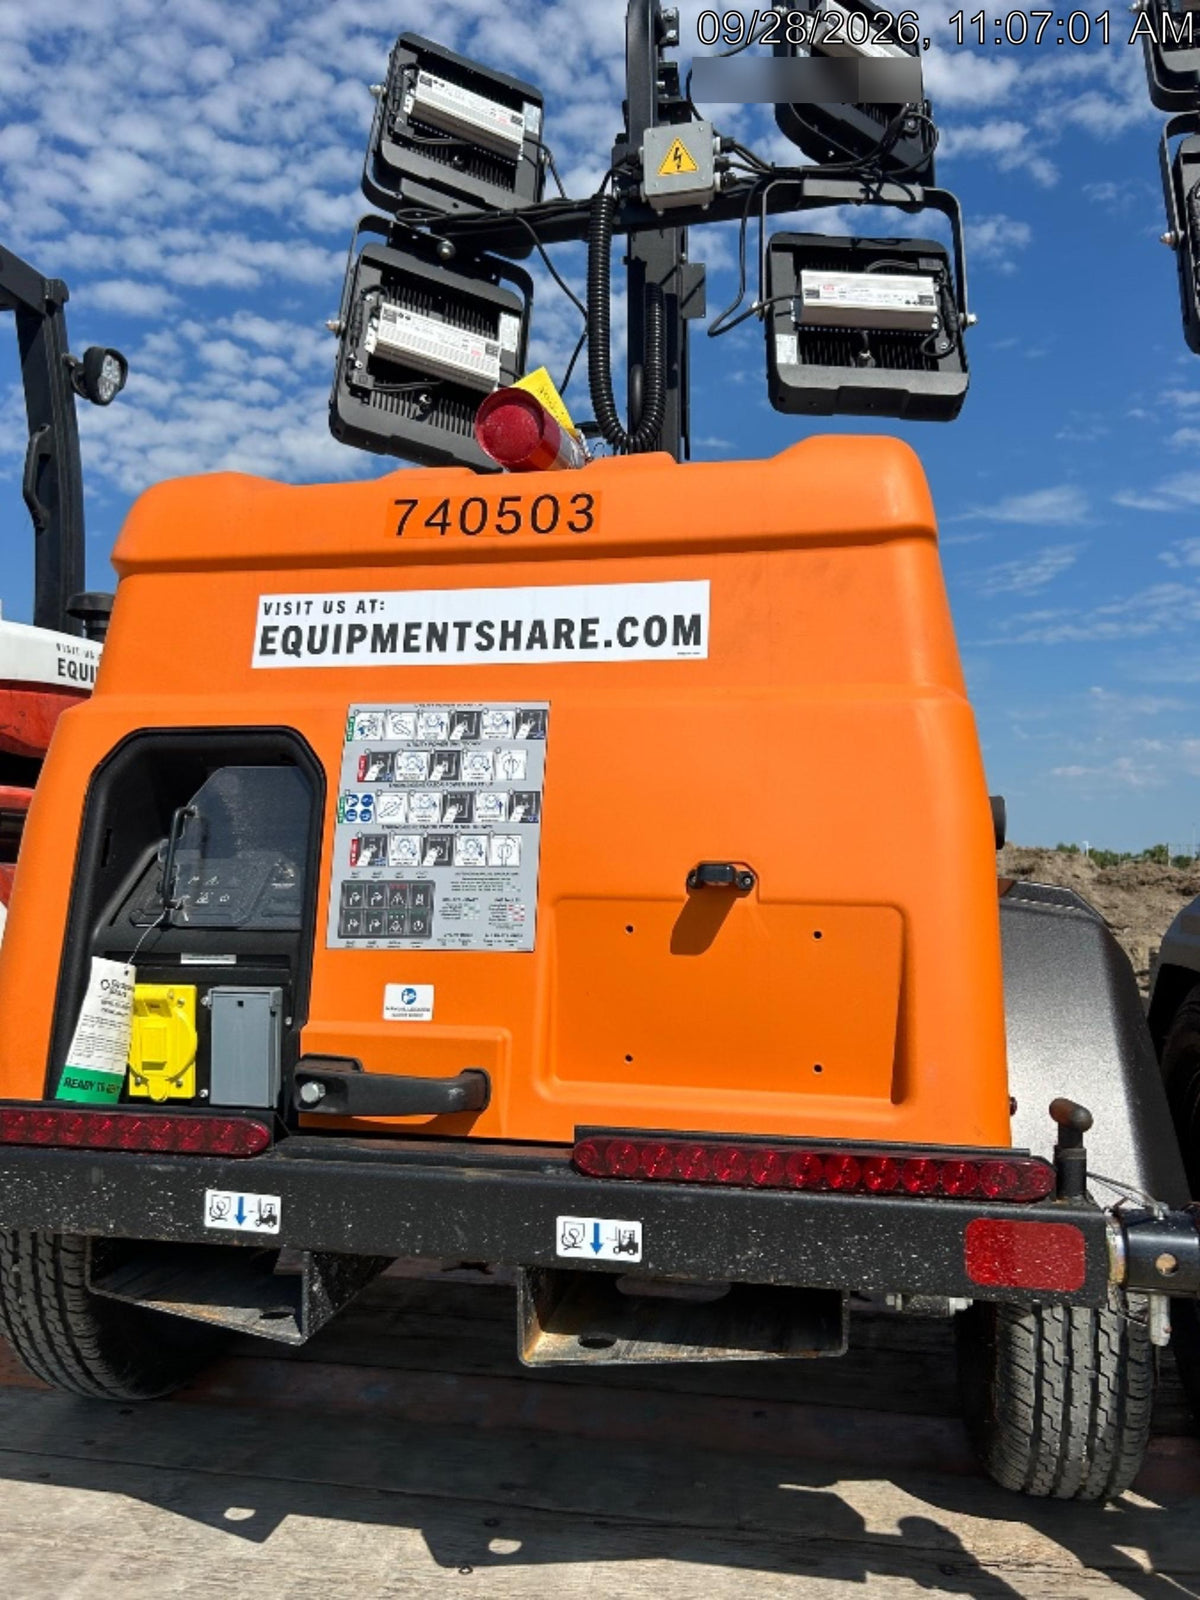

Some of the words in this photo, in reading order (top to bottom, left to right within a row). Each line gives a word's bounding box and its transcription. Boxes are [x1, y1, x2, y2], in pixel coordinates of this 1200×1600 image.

[394, 493, 594, 536] 740503
[263, 601, 313, 616] VISIT
[323, 600, 346, 614] US
[355, 599, 385, 615] AT:
[259, 613, 702, 658] EQUIPMENTSHARE.COM
